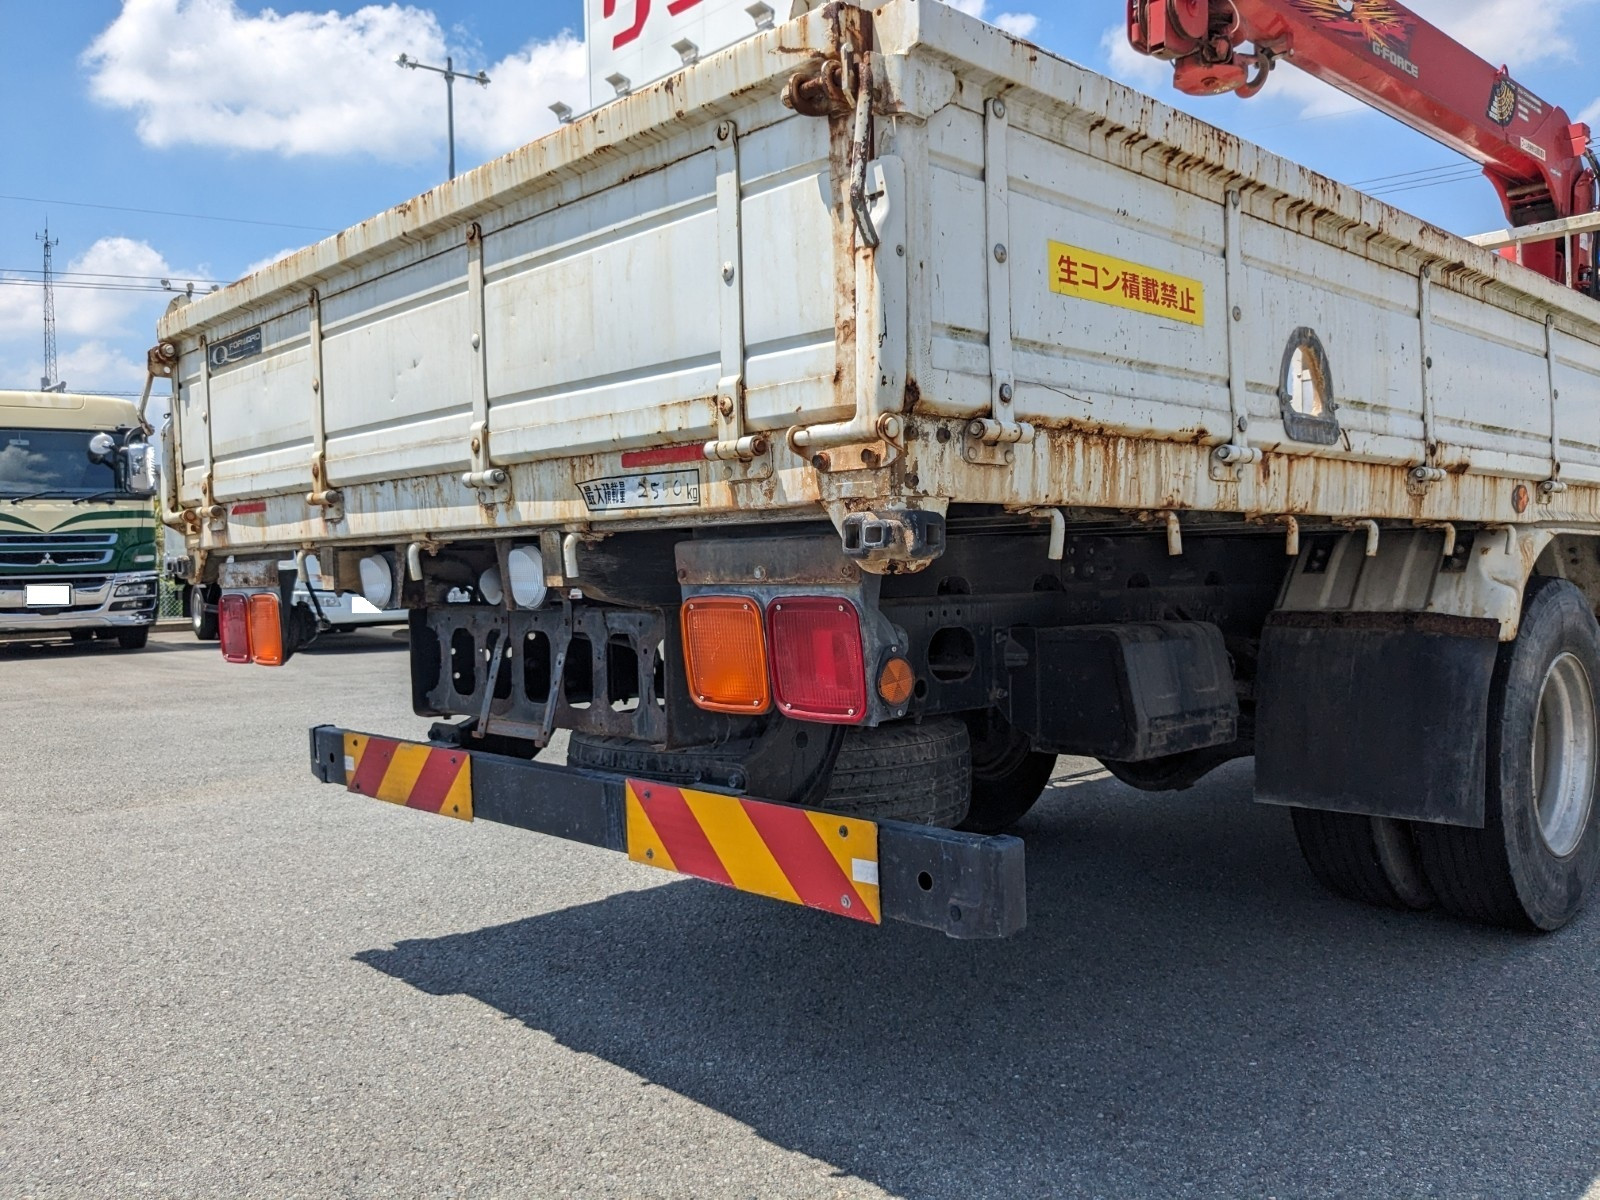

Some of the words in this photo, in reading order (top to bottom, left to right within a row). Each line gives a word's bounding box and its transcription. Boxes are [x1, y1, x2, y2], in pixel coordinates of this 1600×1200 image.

[1057, 255, 1196, 315] 生コン積載禁止
[583, 481, 627, 505] 最大積載量
[686, 483, 698, 501] kg
